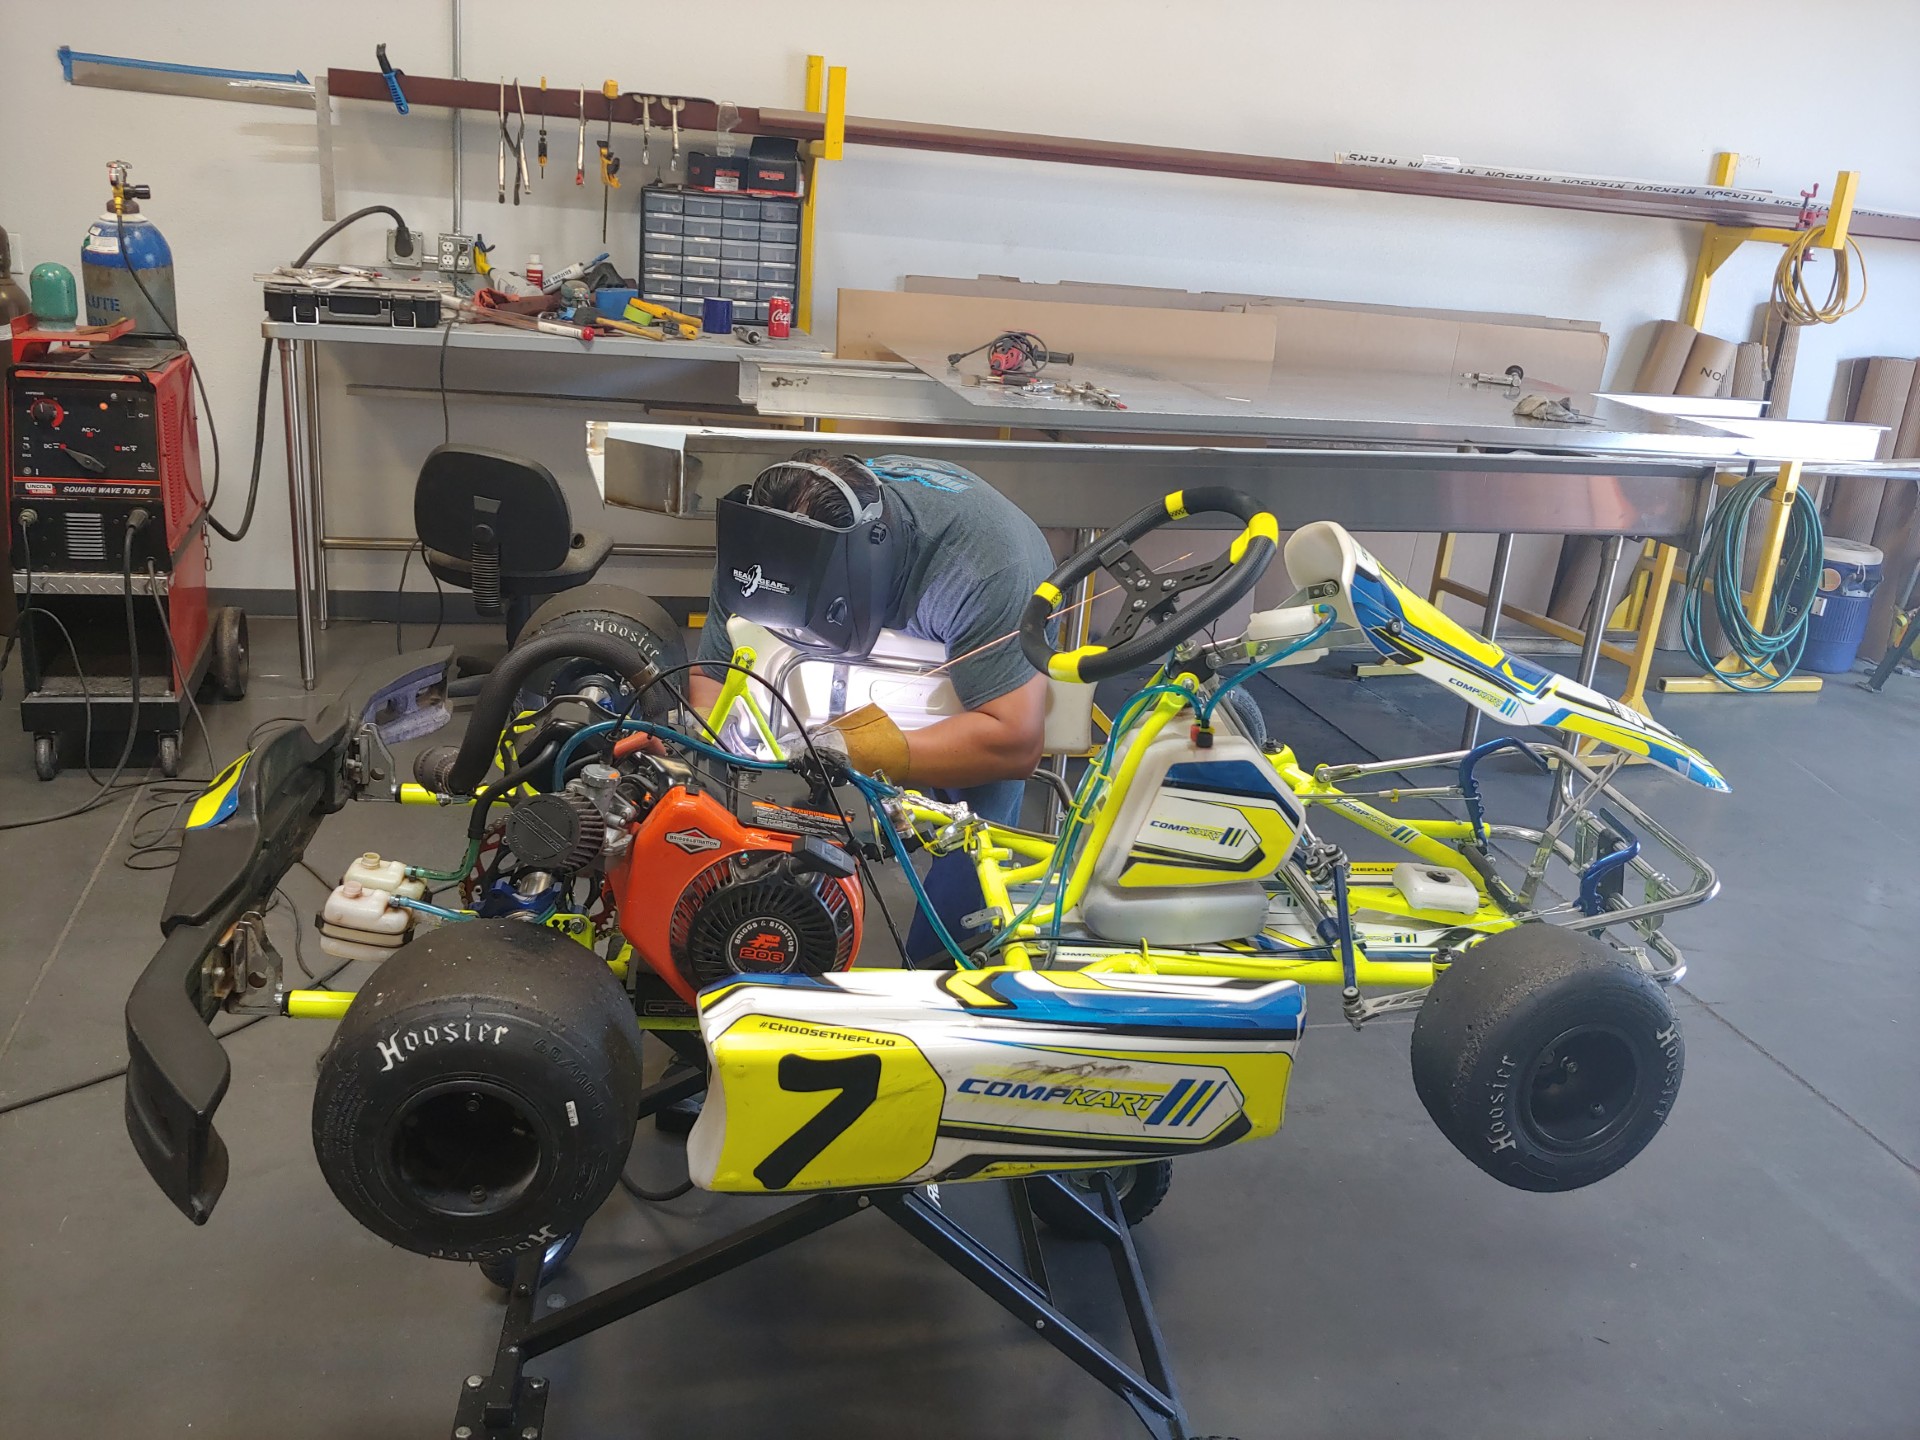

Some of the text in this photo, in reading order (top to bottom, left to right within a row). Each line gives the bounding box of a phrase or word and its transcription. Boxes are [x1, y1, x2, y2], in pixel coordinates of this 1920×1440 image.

[62, 486, 96, 494] SQUARE
[98, 487, 120, 495] WAVE
[592, 617, 660, 658] Hoosier
[1149, 820, 1225, 841] COMPKART
[734, 921, 759, 946] BRIGGS
[768, 920, 795, 953] STRATTON
[739, 946, 785, 964] 206
[376, 1013, 509, 1073] Hoosier
[957, 1077, 1163, 1117] COMPKART
[1486, 1054, 1517, 1154] Hoosier
[752, 1053, 882, 1190] 7
